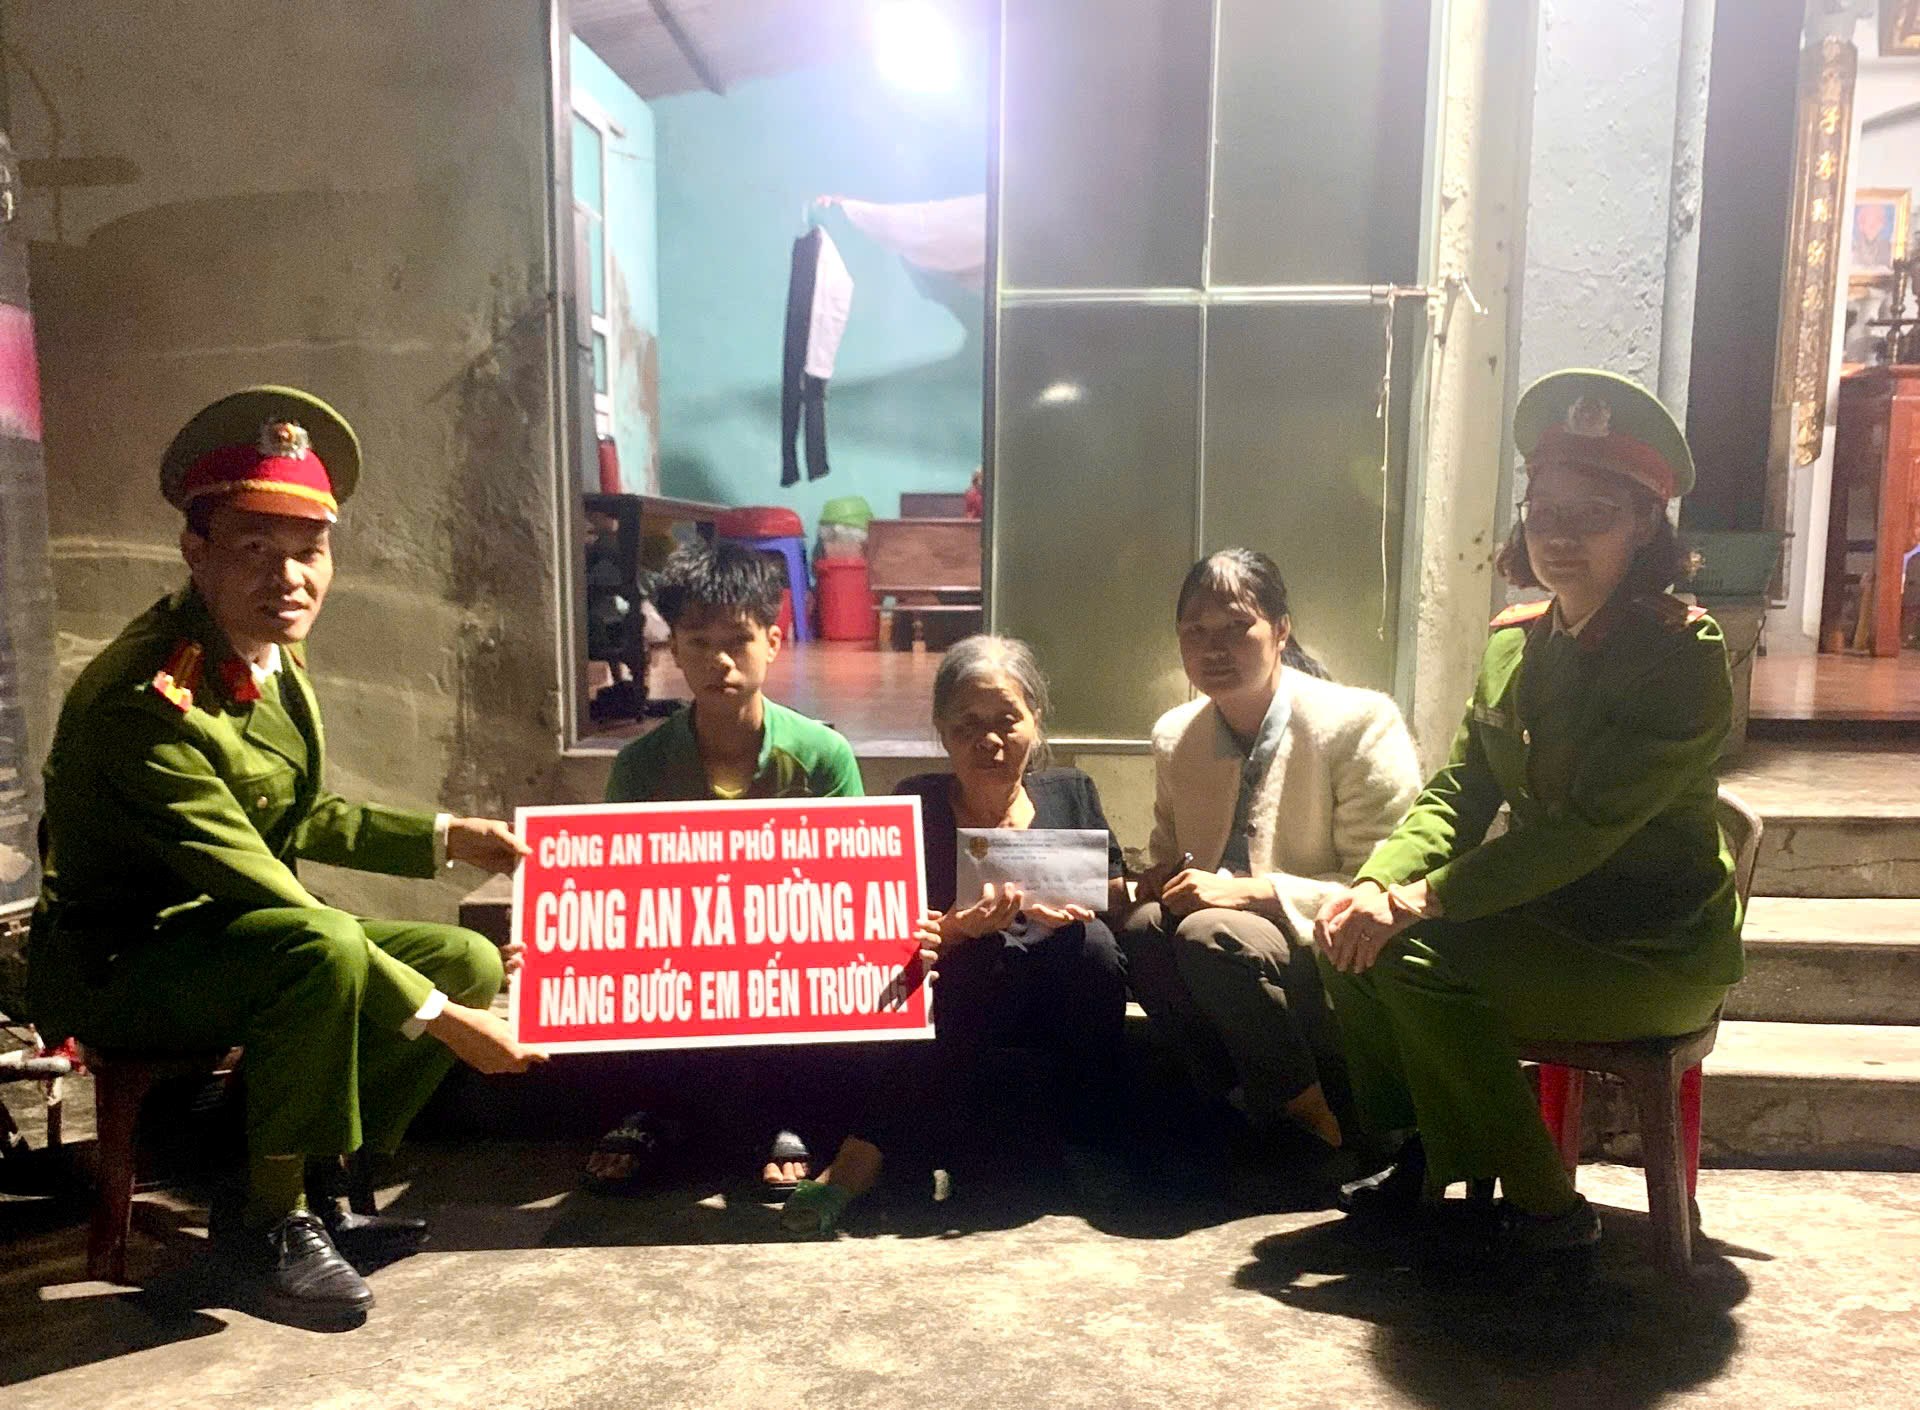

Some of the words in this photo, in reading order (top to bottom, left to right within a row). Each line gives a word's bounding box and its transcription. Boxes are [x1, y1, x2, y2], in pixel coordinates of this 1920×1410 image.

[538, 829, 604, 869] CÔNG
[609, 833, 643, 866] AN
[647, 826, 724, 865] THÀNH
[729, 817, 776, 862] PHỐ
[781, 815, 820, 860] HẢI
[824, 819, 903, 859] PHÒNG
[535, 878, 627, 953] CÔNG
[635, 887, 682, 949] AN
[691, 874, 737, 947] XÃ
[743, 867, 855, 945] ĐƯỜNG
[863, 880, 910, 941] AN
[539, 966, 615, 1027] NÂNG
[622, 958, 693, 1023] BƯỚC
[700, 970, 741, 1020] EM
[747, 951, 801, 1018] ĐẾN
